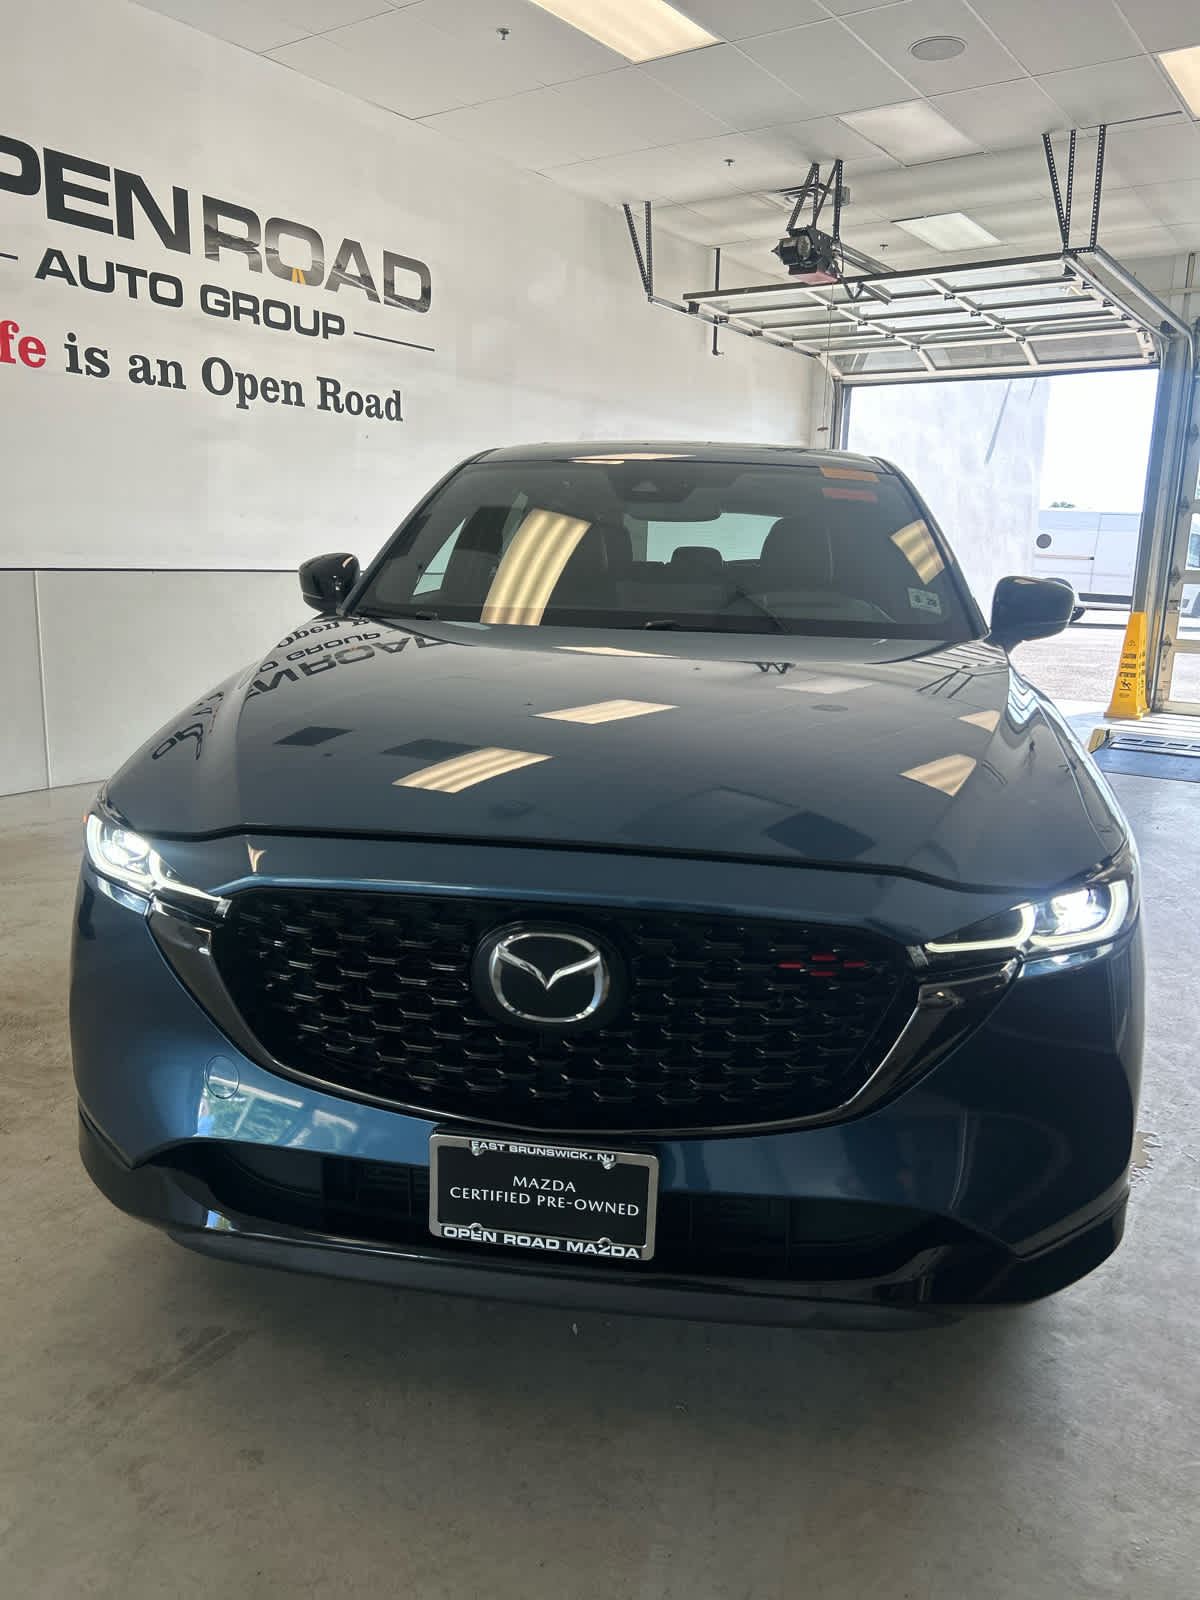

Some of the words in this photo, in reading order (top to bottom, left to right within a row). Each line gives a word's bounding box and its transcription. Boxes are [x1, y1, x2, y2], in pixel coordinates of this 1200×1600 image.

[202, 194, 432, 314] ROAD
[35, 248, 184, 308] AUTO
[200, 284, 346, 339] GROUP
[65, 332, 111, 379] is
[128, 354, 187, 391] an
[201, 356, 306, 410] Open
[316, 376, 404, 422] Road
[471, 1140, 505, 1152] EAST
[596, 1153, 616, 1162] NJ
[512, 1175, 577, 1193] MAZDA
[450, 1186, 531, 1205] CERTIFIED
[537, 1195, 640, 1217] PRE-OWNED
[443, 1226, 497, 1244] OPEN
[503, 1233, 560, 1250] ROAD
[566, 1241, 641, 1259] MAZDA
